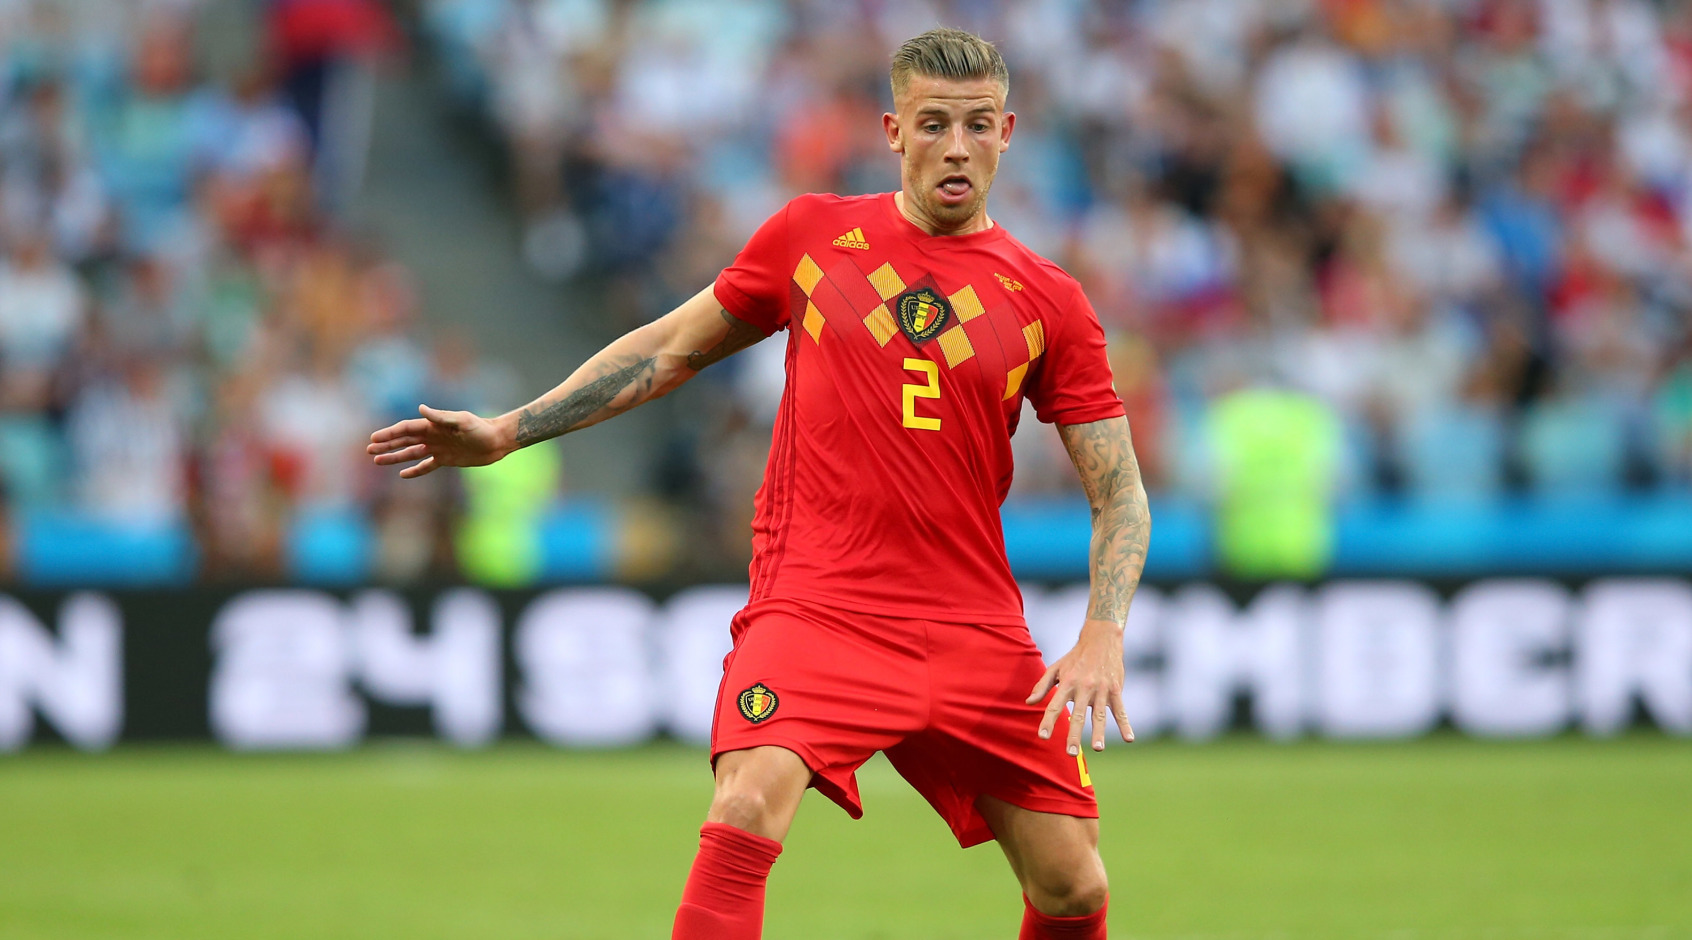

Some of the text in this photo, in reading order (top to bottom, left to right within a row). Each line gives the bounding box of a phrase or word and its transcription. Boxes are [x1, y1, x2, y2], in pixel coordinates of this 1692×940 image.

[832, 239, 870, 250] adidas
[902, 357, 941, 431] 2
[207, 588, 503, 750] 24
